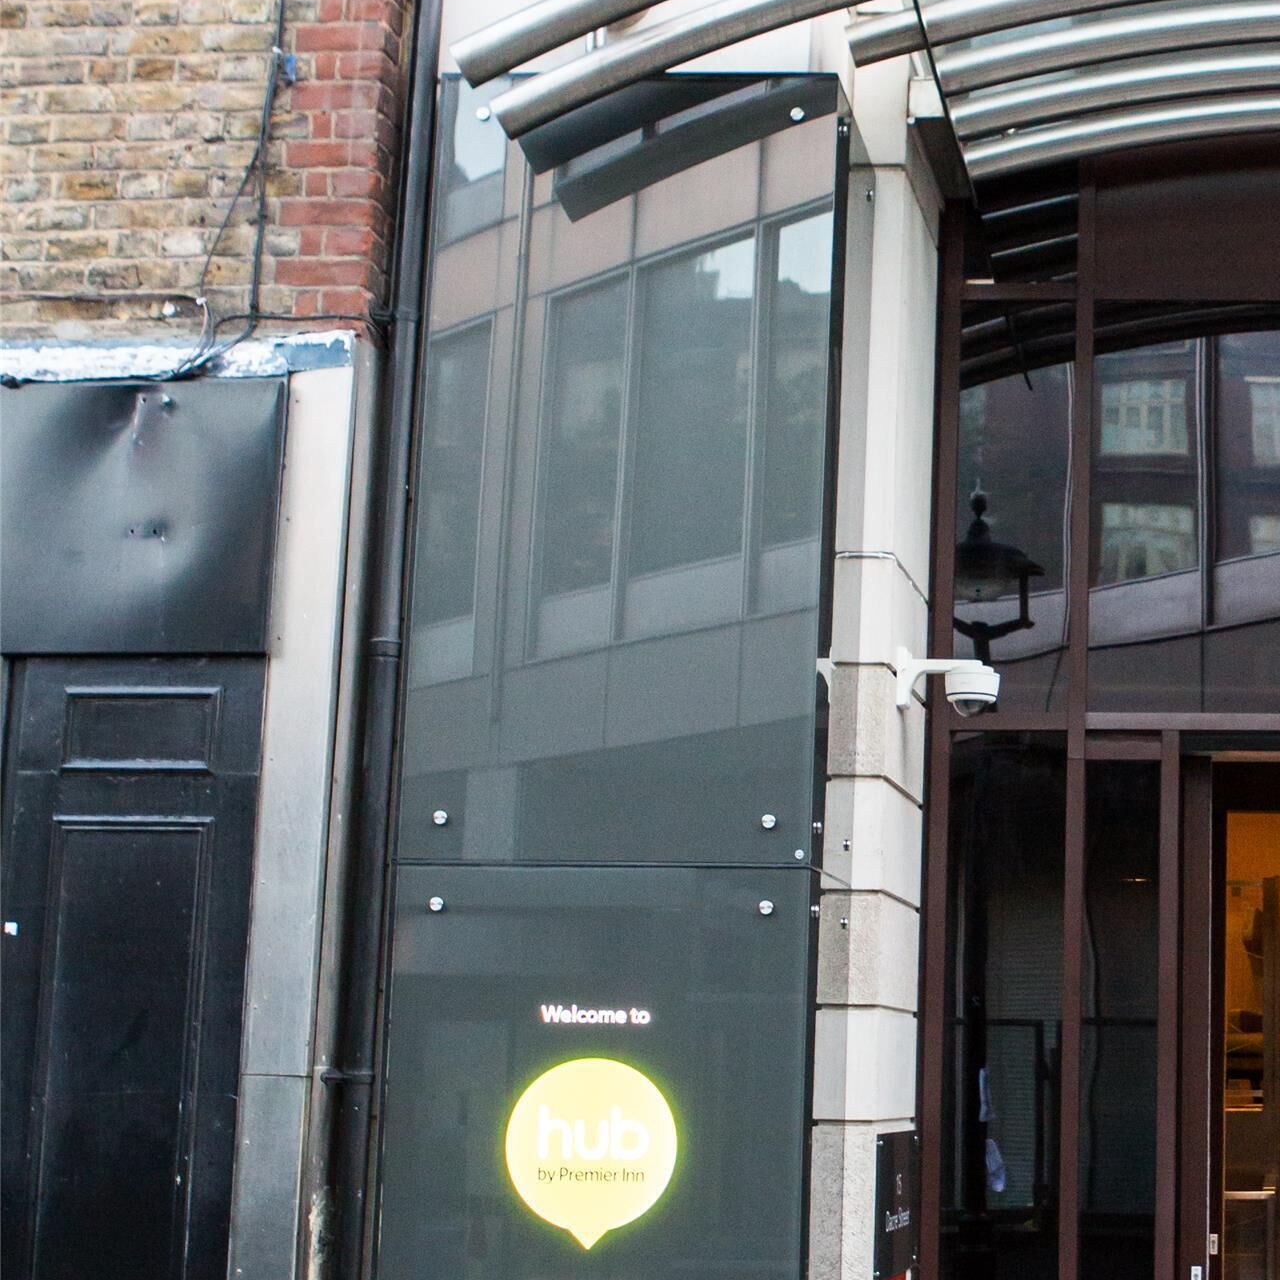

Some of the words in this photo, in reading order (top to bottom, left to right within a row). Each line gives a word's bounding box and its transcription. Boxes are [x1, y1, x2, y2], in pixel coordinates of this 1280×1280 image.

[541, 1004, 628, 1024] Welcome
[629, 1007, 651, 1024] to
[537, 1103, 649, 1160] hub
[538, 1167, 555, 1185] by
[559, 1167, 617, 1182] Premier
[622, 1167, 645, 1182] Inn
